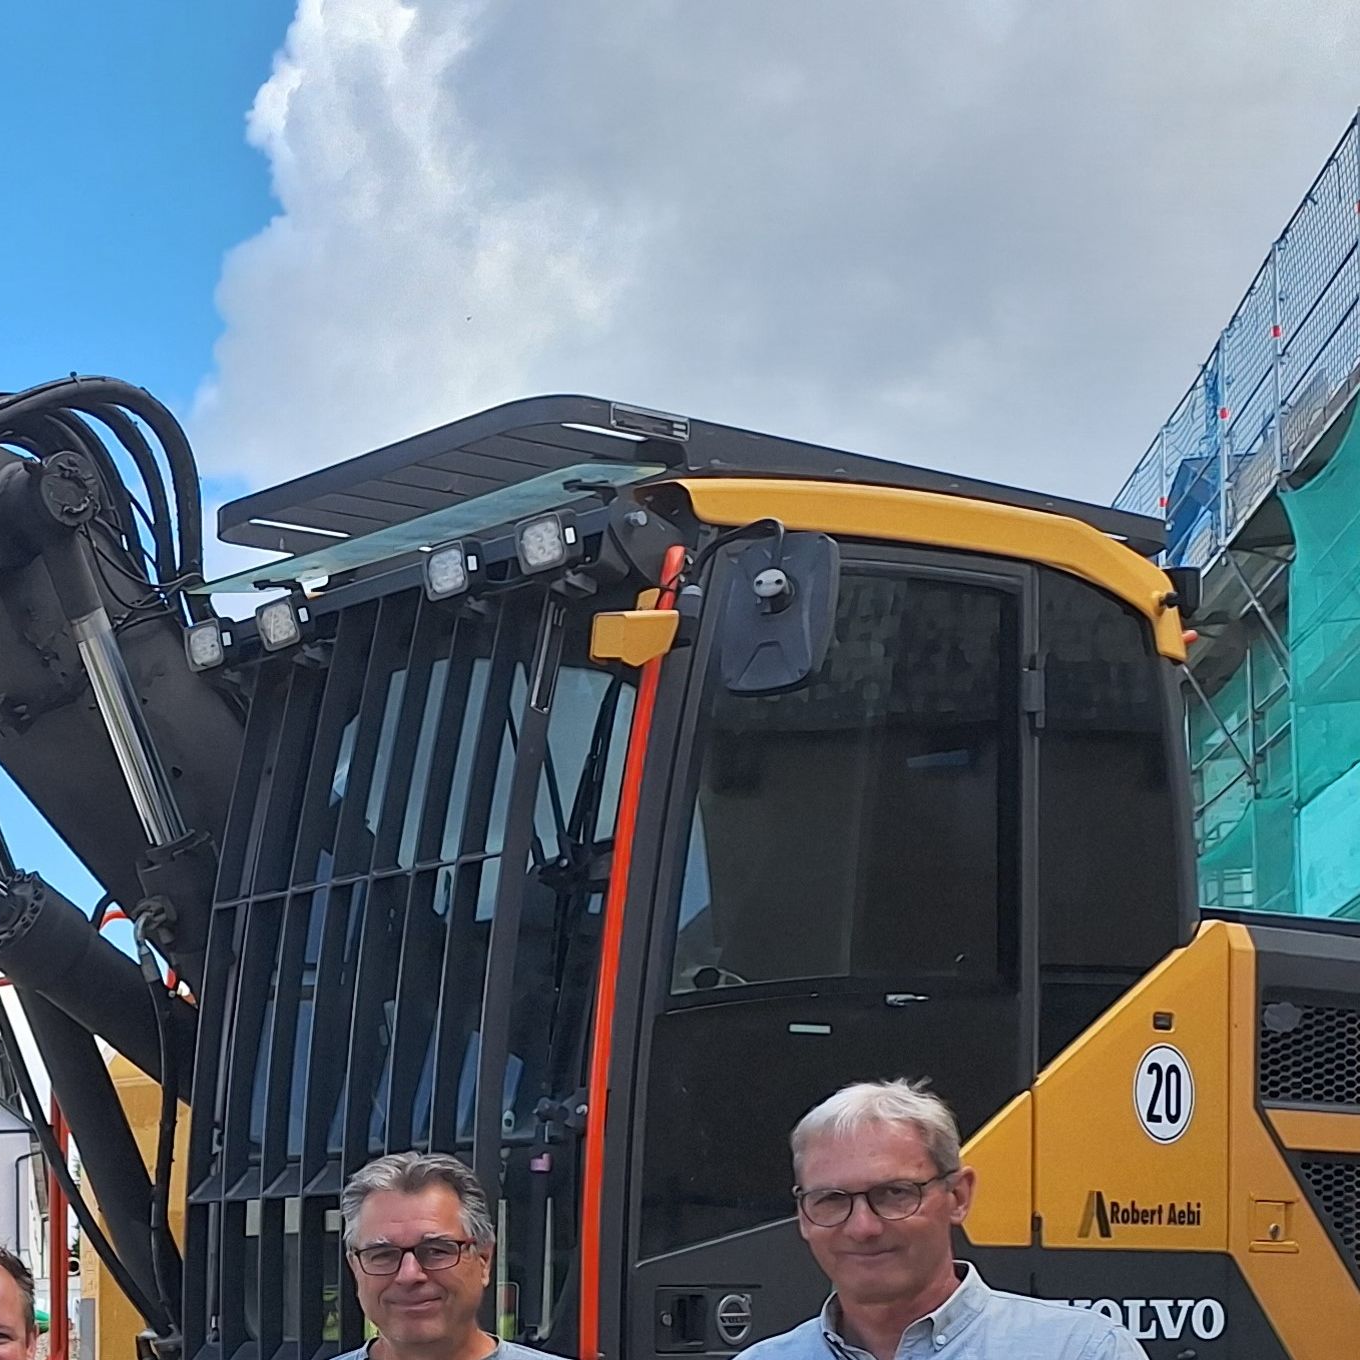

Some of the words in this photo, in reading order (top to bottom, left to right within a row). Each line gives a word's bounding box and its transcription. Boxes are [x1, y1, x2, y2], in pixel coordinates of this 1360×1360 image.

[1146, 1062, 1182, 1124] 20
[1110, 1200, 1163, 1225] Robert
[1167, 1201, 1201, 1226] Aebi
[1068, 1298, 1225, 1340] OLVO
